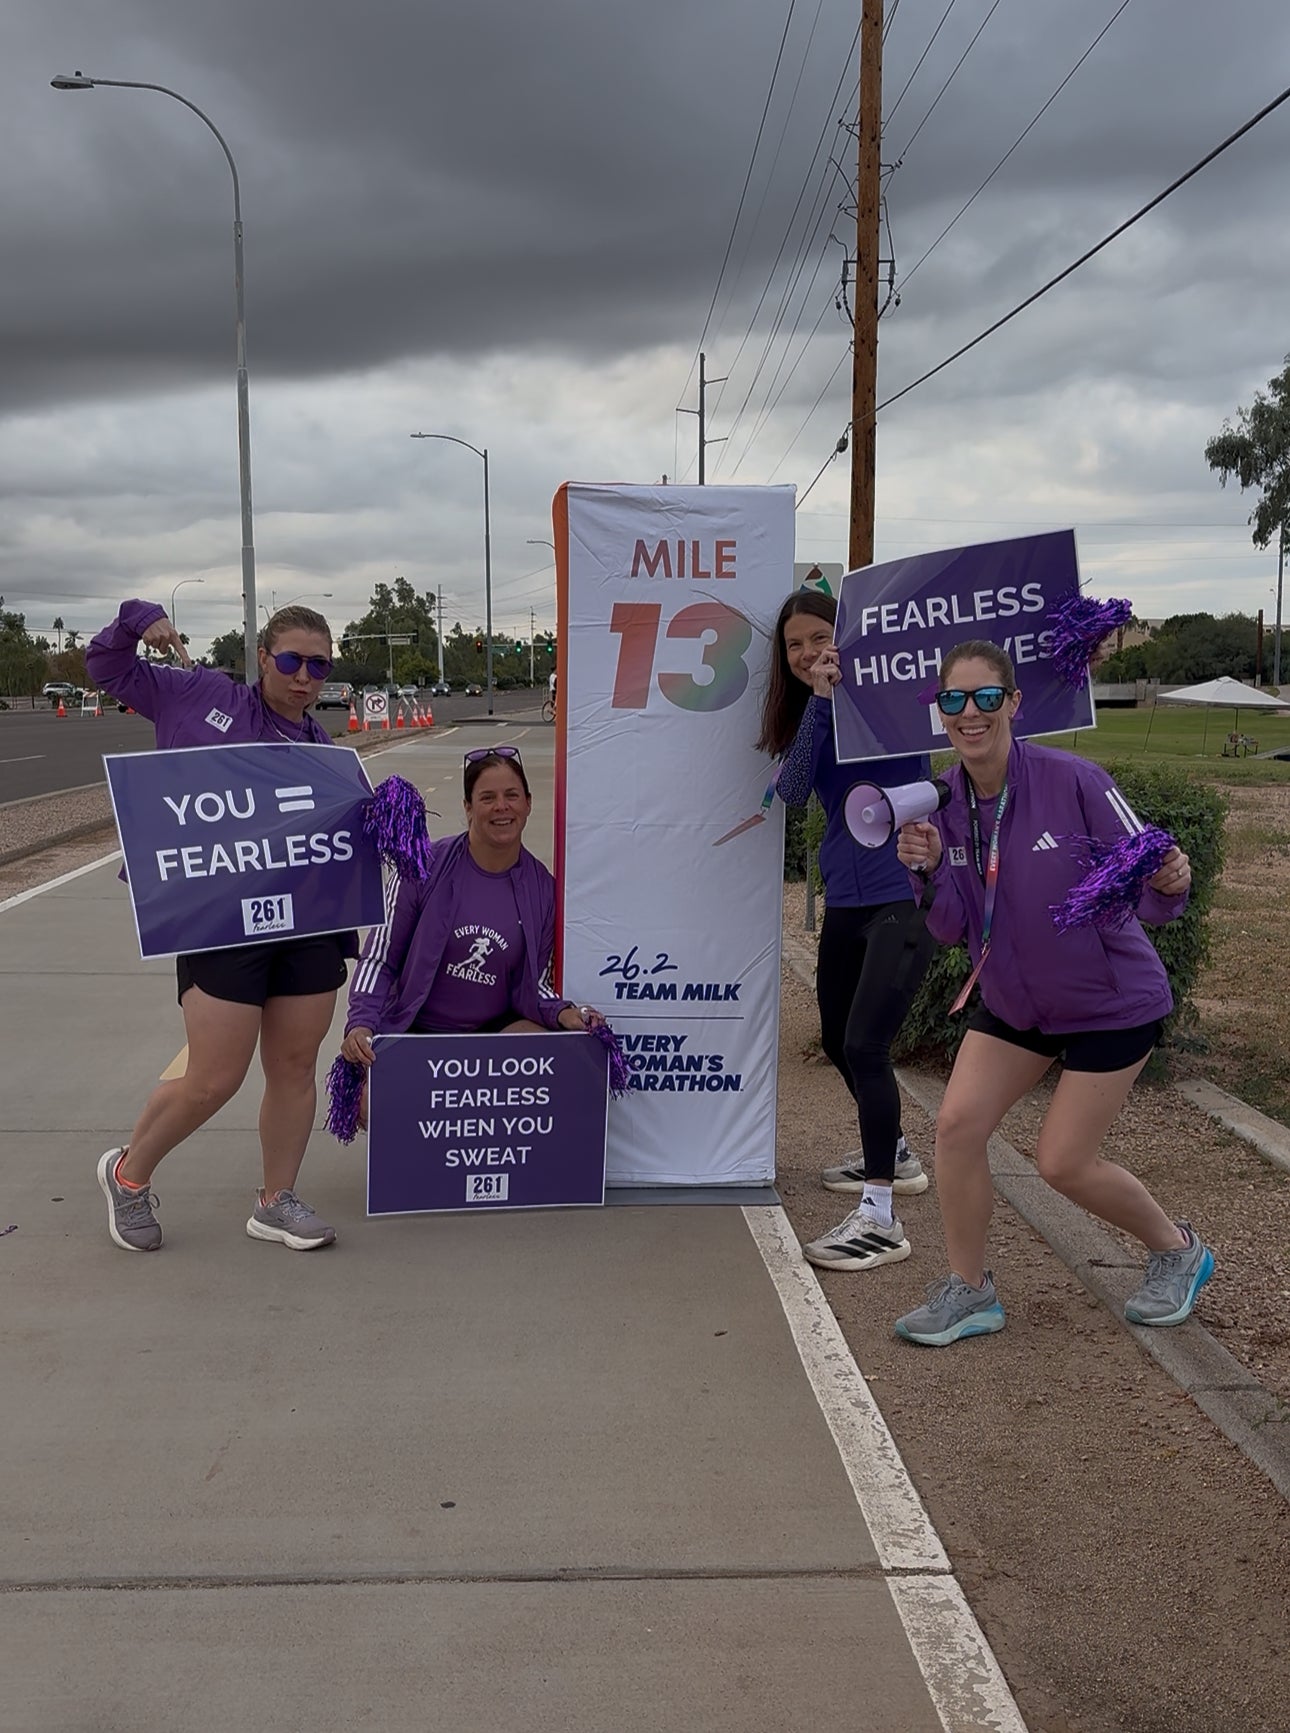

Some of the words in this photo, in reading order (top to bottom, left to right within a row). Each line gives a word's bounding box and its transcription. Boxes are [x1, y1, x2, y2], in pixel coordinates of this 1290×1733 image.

[631, 539, 736, 578] MILE
[861, 583, 1045, 636] FEARLESS
[610, 602, 752, 712] 13
[854, 647, 942, 686] HIGH
[211, 712, 230, 727] 261
[163, 788, 256, 825] YOU
[156, 830, 354, 881] FEARLESS
[953, 848, 965, 861] 26
[250, 898, 285, 923] 261
[454, 924, 480, 939] EVERY
[481, 926, 509, 951] WOMAN
[446, 963, 497, 986] FEARLESS
[599, 945, 679, 981] 26.2
[614, 982, 678, 1000] TEAM
[681, 983, 742, 1001] MILK
[428, 1059, 480, 1078] YOU
[488, 1057, 554, 1076] LOOK
[624, 1054, 724, 1072] OMAN'S
[431, 1087, 550, 1108] FEARLESS
[418, 1118, 495, 1138] WHEN
[502, 1116, 553, 1135] YOU
[445, 1146, 532, 1167] SWEAT
[473, 1175, 502, 1193] 261
